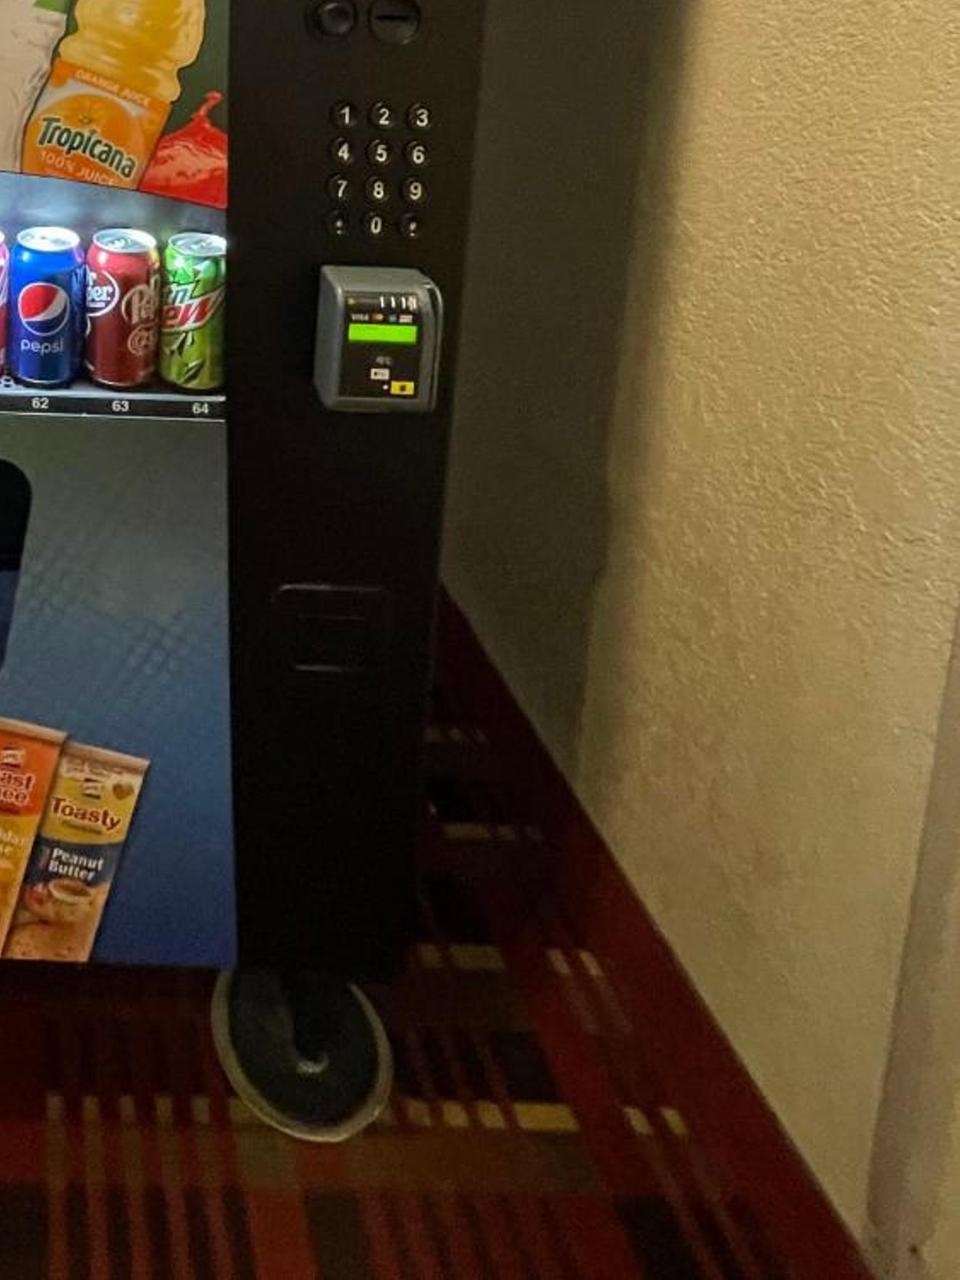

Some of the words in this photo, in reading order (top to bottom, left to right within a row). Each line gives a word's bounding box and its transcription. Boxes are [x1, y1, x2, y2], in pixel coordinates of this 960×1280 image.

[340, 106, 350, 124] 1
[379, 108, 389, 125] 2
[416, 108, 429, 127] 3
[38, 116, 137, 178] Tropicana
[338, 143, 349, 161] 4
[376, 145, 387, 162] 5
[412, 146, 425, 164] 6
[42, 150, 75, 174] 100%
[337, 180, 347, 198] 7
[373, 181, 384, 198] 8
[410, 182, 422, 200] 9
[371, 217, 382, 234] 0
[21, 338, 64, 358] pepsi
[31, 397, 49, 409] 62
[112, 400, 129, 412] 63
[192, 403, 209, 414] 64
[51, 796, 122, 831] Toasty
[53, 847, 104, 871] Peanut
[49, 860, 96, 881] Butter
